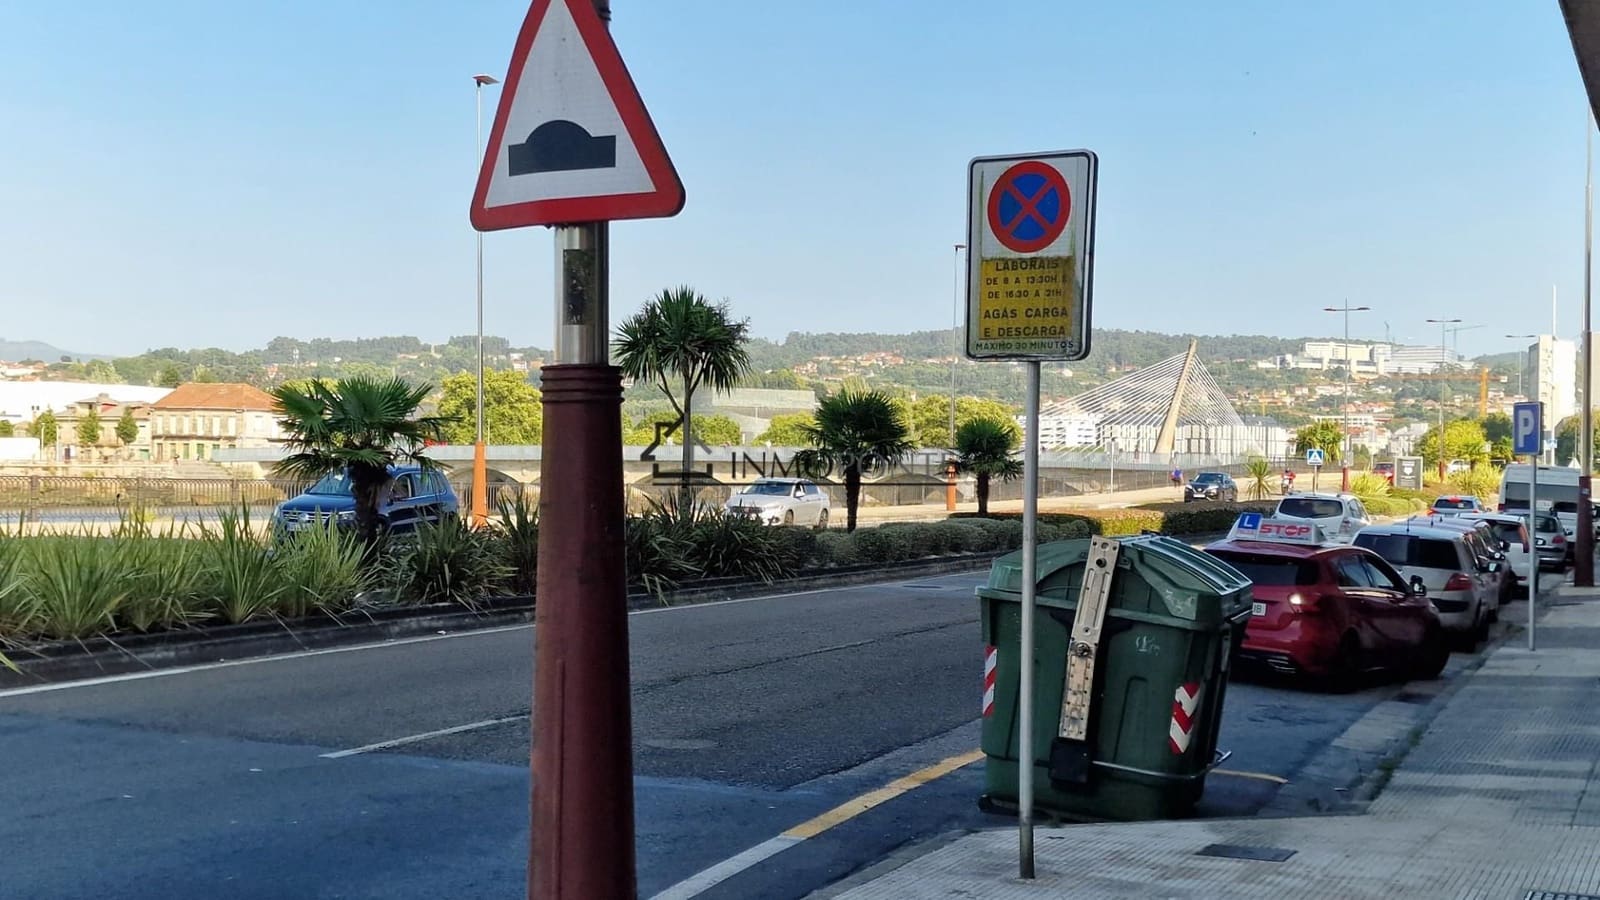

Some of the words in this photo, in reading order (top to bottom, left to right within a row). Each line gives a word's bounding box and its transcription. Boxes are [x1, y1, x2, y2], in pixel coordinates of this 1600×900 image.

[995, 259, 1059, 271] LABORAIS
[986, 277, 999, 285] DE
[988, 291, 1000, 299] DE
[1034, 289, 1042, 297] A
[1025, 307, 1067, 318] CARGA
[984, 328, 991, 337] E
[998, 326, 1066, 337] DESCARGA
[1015, 342, 1027, 350] 30
[1029, 340, 1074, 350] MINUTOS
[1518, 410, 1534, 447] P
[1243, 515, 1253, 527] L
[1259, 524, 1311, 536] STOP
